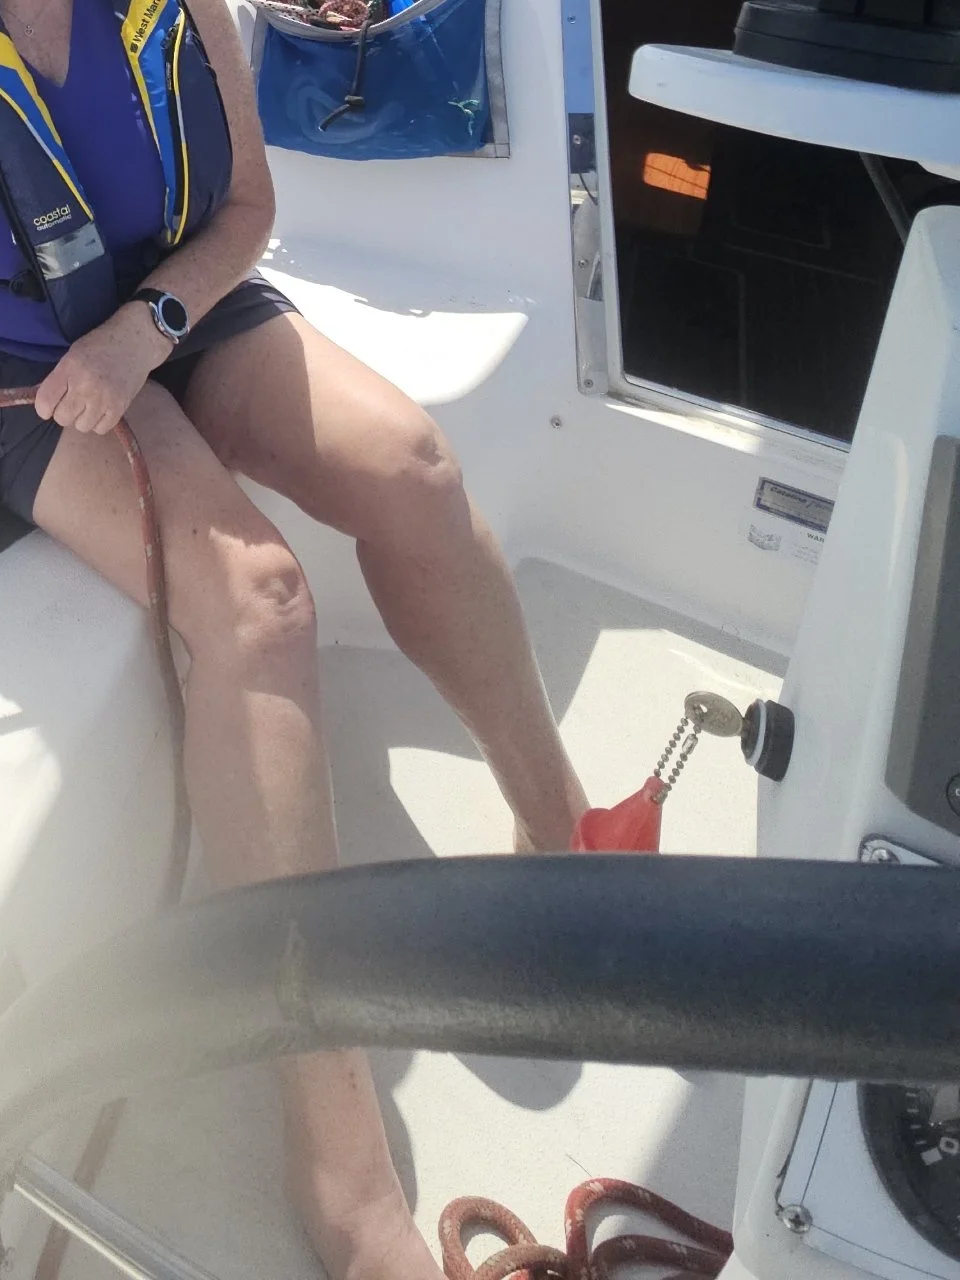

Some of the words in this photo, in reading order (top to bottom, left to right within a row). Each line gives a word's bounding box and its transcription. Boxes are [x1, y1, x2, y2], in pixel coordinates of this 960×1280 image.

[132, 18, 150, 42] West
[33, 204, 71, 226] coastal
[36, 214, 72, 231] automatic
